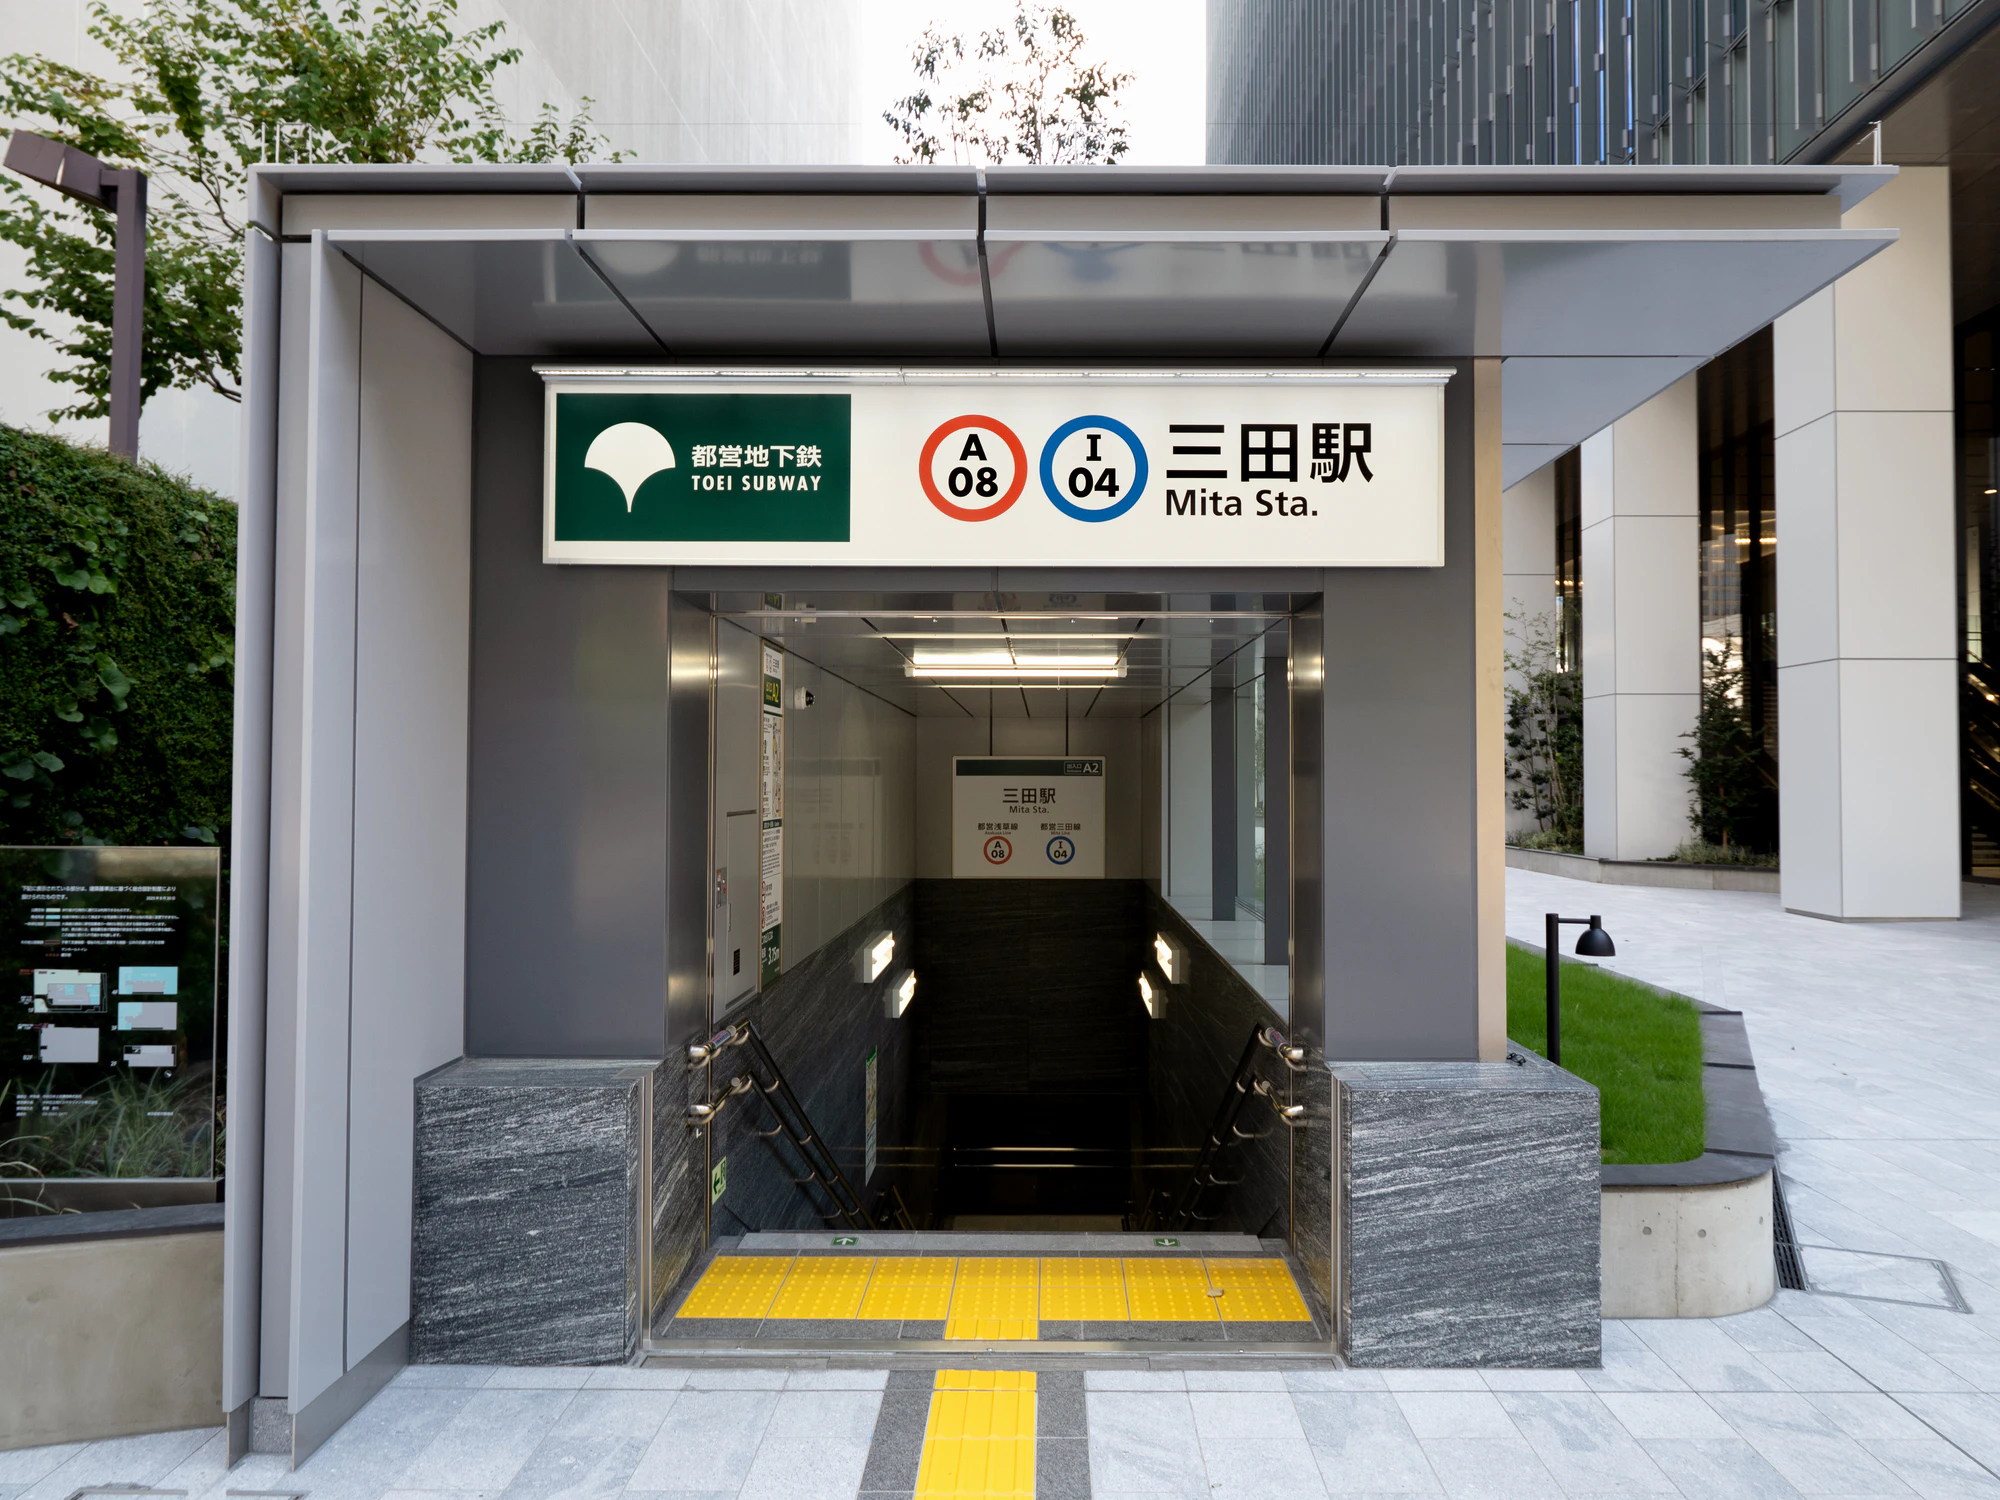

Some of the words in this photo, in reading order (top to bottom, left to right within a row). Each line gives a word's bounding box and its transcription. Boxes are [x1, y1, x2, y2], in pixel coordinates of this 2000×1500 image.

[960, 433, 987, 461] A
[1085, 433, 1103, 461] I
[1166, 422, 1374, 484] 三田駅
[691, 444, 822, 468] 都営地下鉄
[691, 475, 732, 491] TOEI
[741, 475, 822, 491] SUBWAY
[948, 467, 1000, 499] 08
[1068, 467, 1121, 499] 04
[1166, 487, 1242, 517] Mita
[1255, 488, 1319, 517] Sta.
[772, 682, 779, 703] A2
[1083, 763, 1099, 773] A2
[1002, 787, 1056, 804] 三田駅
[1009, 806, 1030, 814] Mita
[1033, 806, 1050, 814] Sta.
[978, 823, 1019, 831] 都営浅草線
[1040, 823, 1081, 831] 都営三田線
[994, 841, 1002, 849] A
[1058, 841, 1063, 849] I
[991, 850, 1005, 859] 08
[1053, 850, 1068, 859] 04
